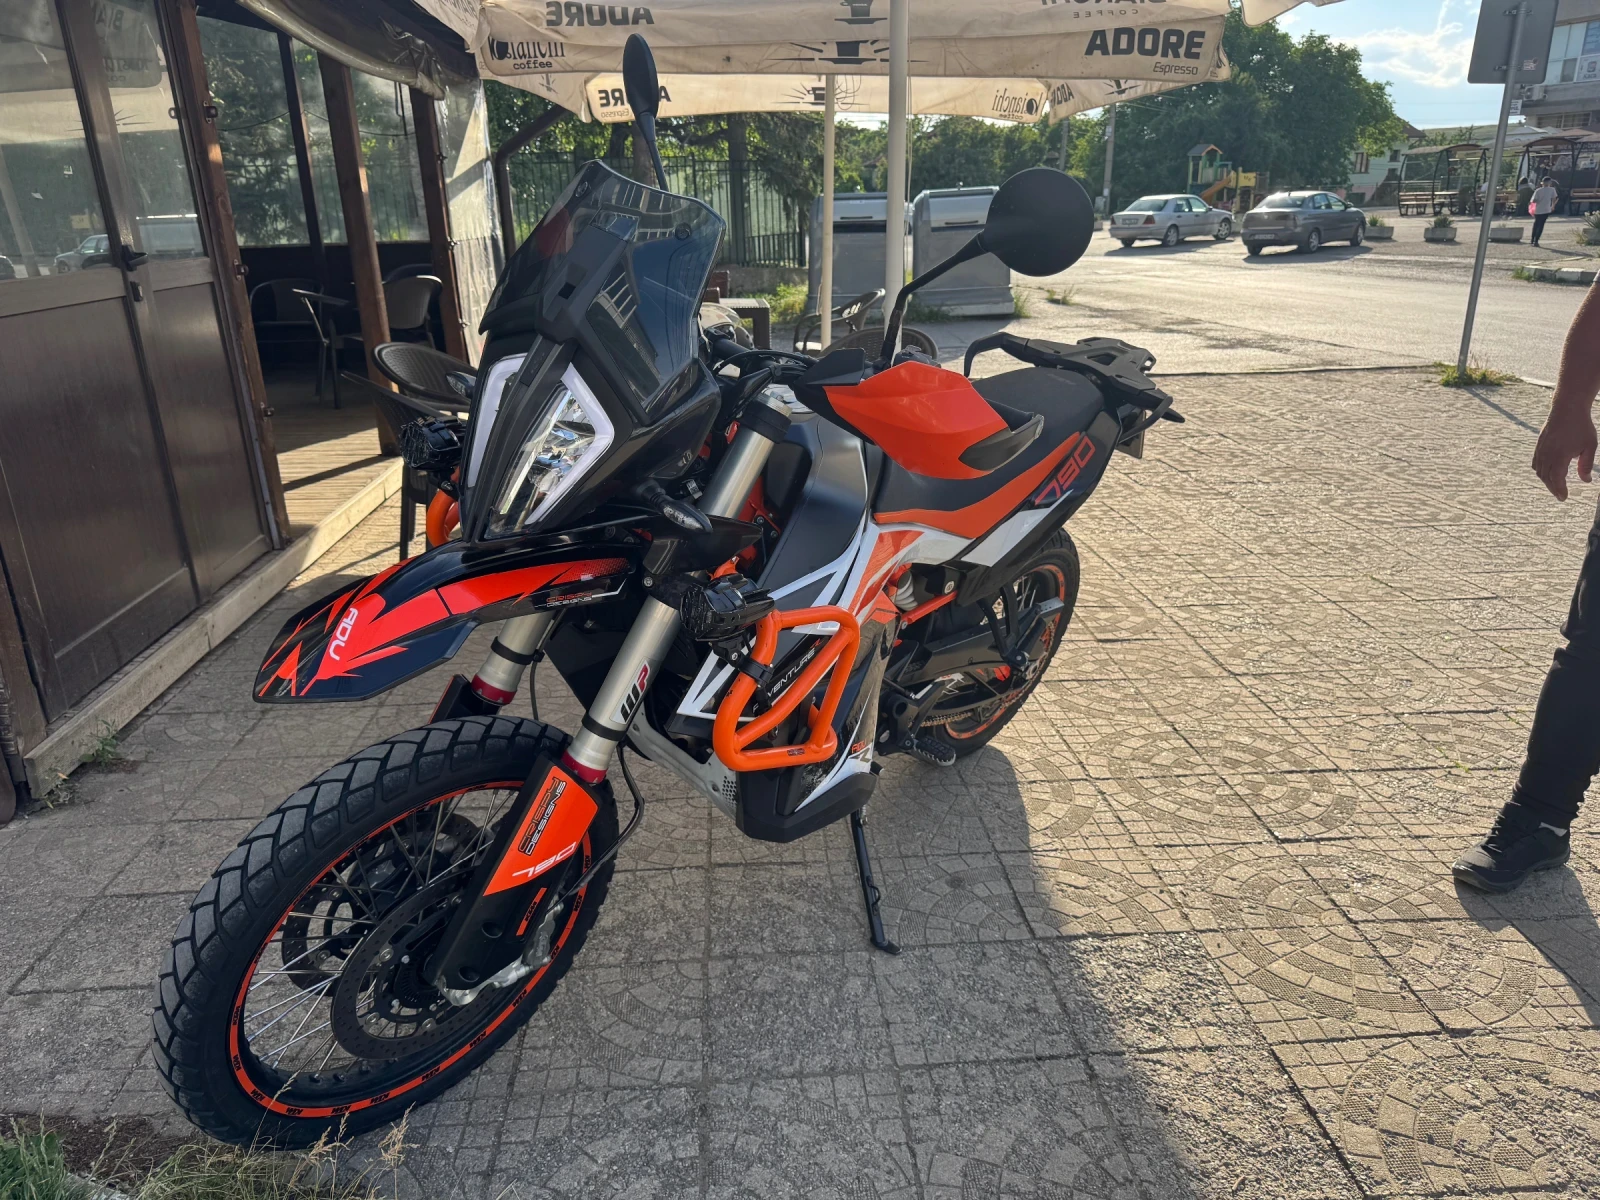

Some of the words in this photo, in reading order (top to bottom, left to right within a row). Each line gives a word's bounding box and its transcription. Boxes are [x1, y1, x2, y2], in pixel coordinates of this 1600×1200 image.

[513, 60, 553, 70] coffee
[1085, 27, 1206, 60] ADORE
[1152, 61, 1199, 76] Espresso
[1034, 435, 1096, 506] 790
[620, 663, 650, 723] WP
[519, 777, 560, 852] CRISPY
[525, 781, 566, 855] DESIGNS
[512, 841, 577, 878] 790
